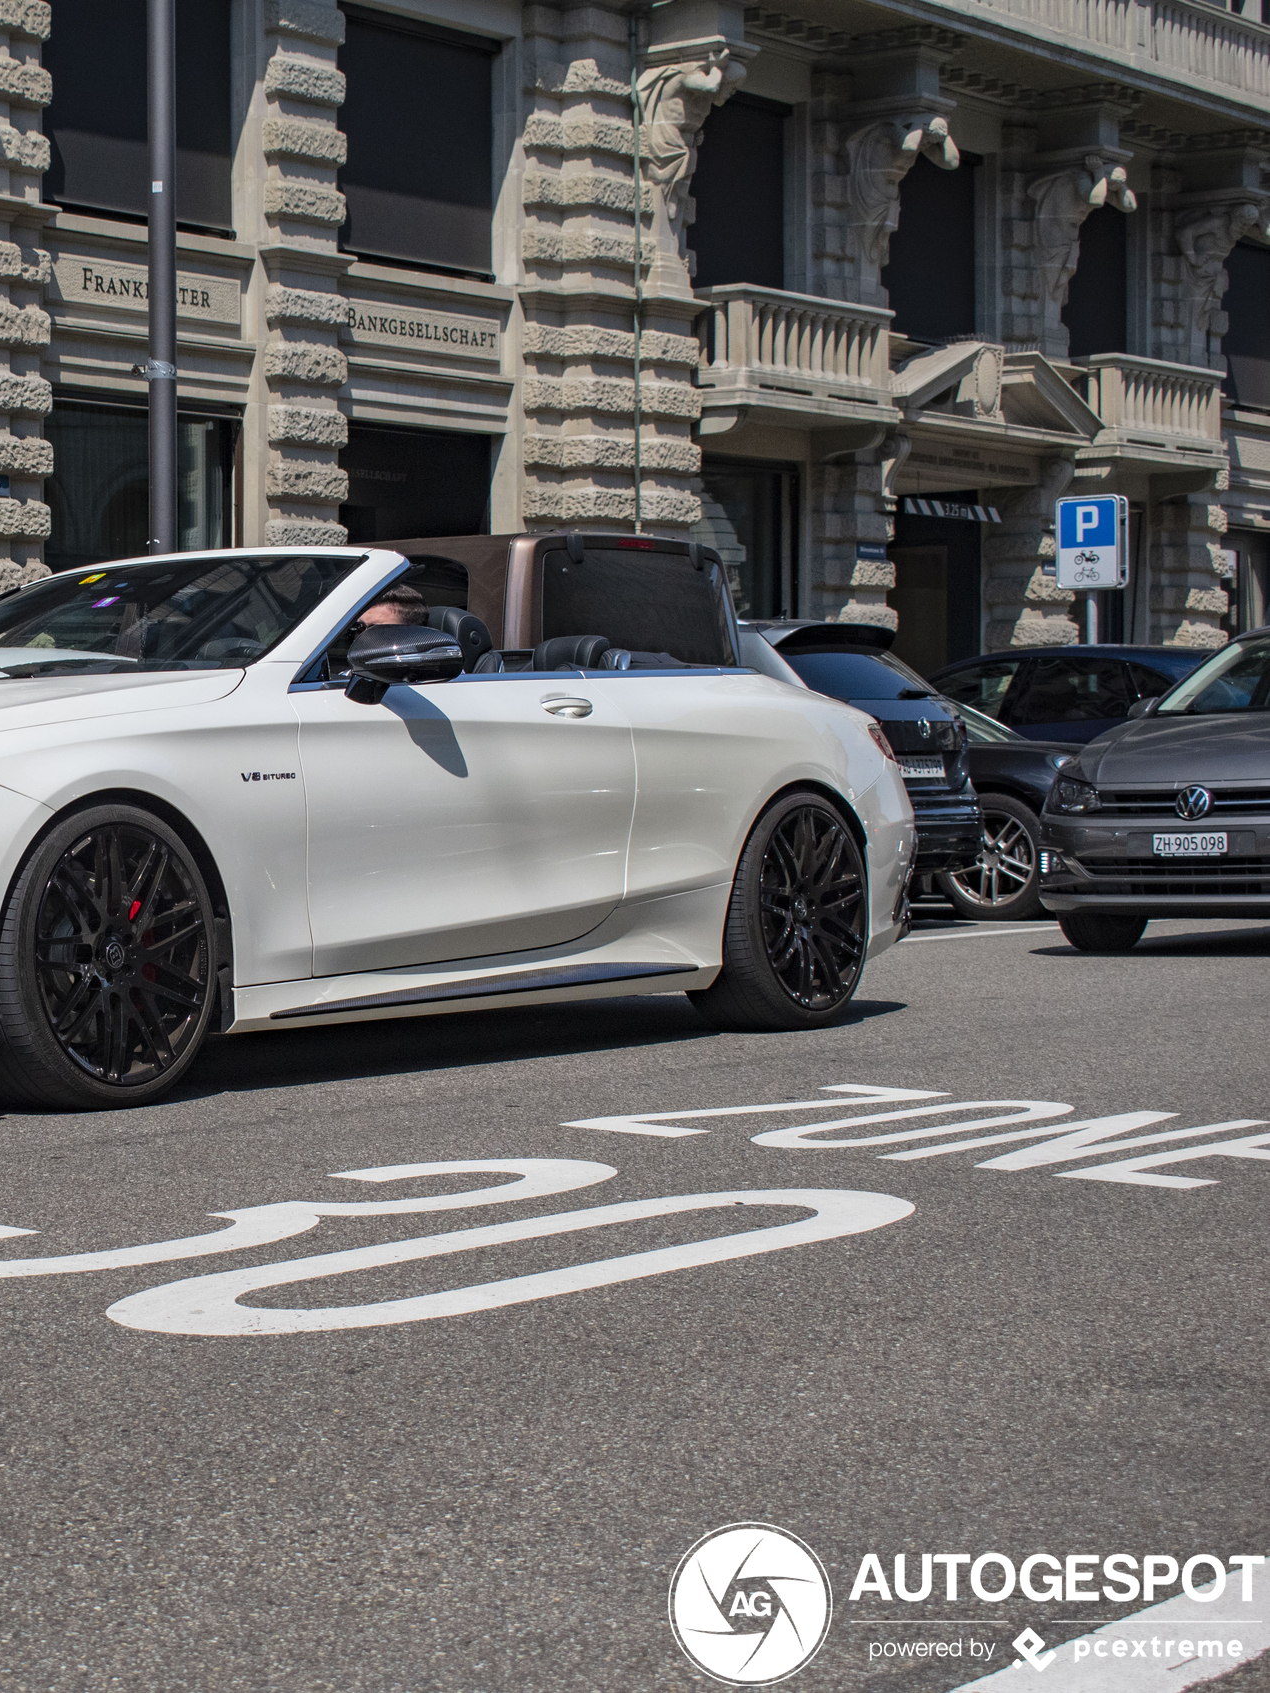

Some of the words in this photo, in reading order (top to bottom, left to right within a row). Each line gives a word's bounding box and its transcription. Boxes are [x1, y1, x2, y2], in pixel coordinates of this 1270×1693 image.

[347, 307, 497, 348] BANKGESELLSCHAFT
[945, 503, 959, 516] 3.25
[1076, 505, 1099, 543] P
[241, 771, 261, 782] V8
[560, 1083, 1270, 1189] ZONE
